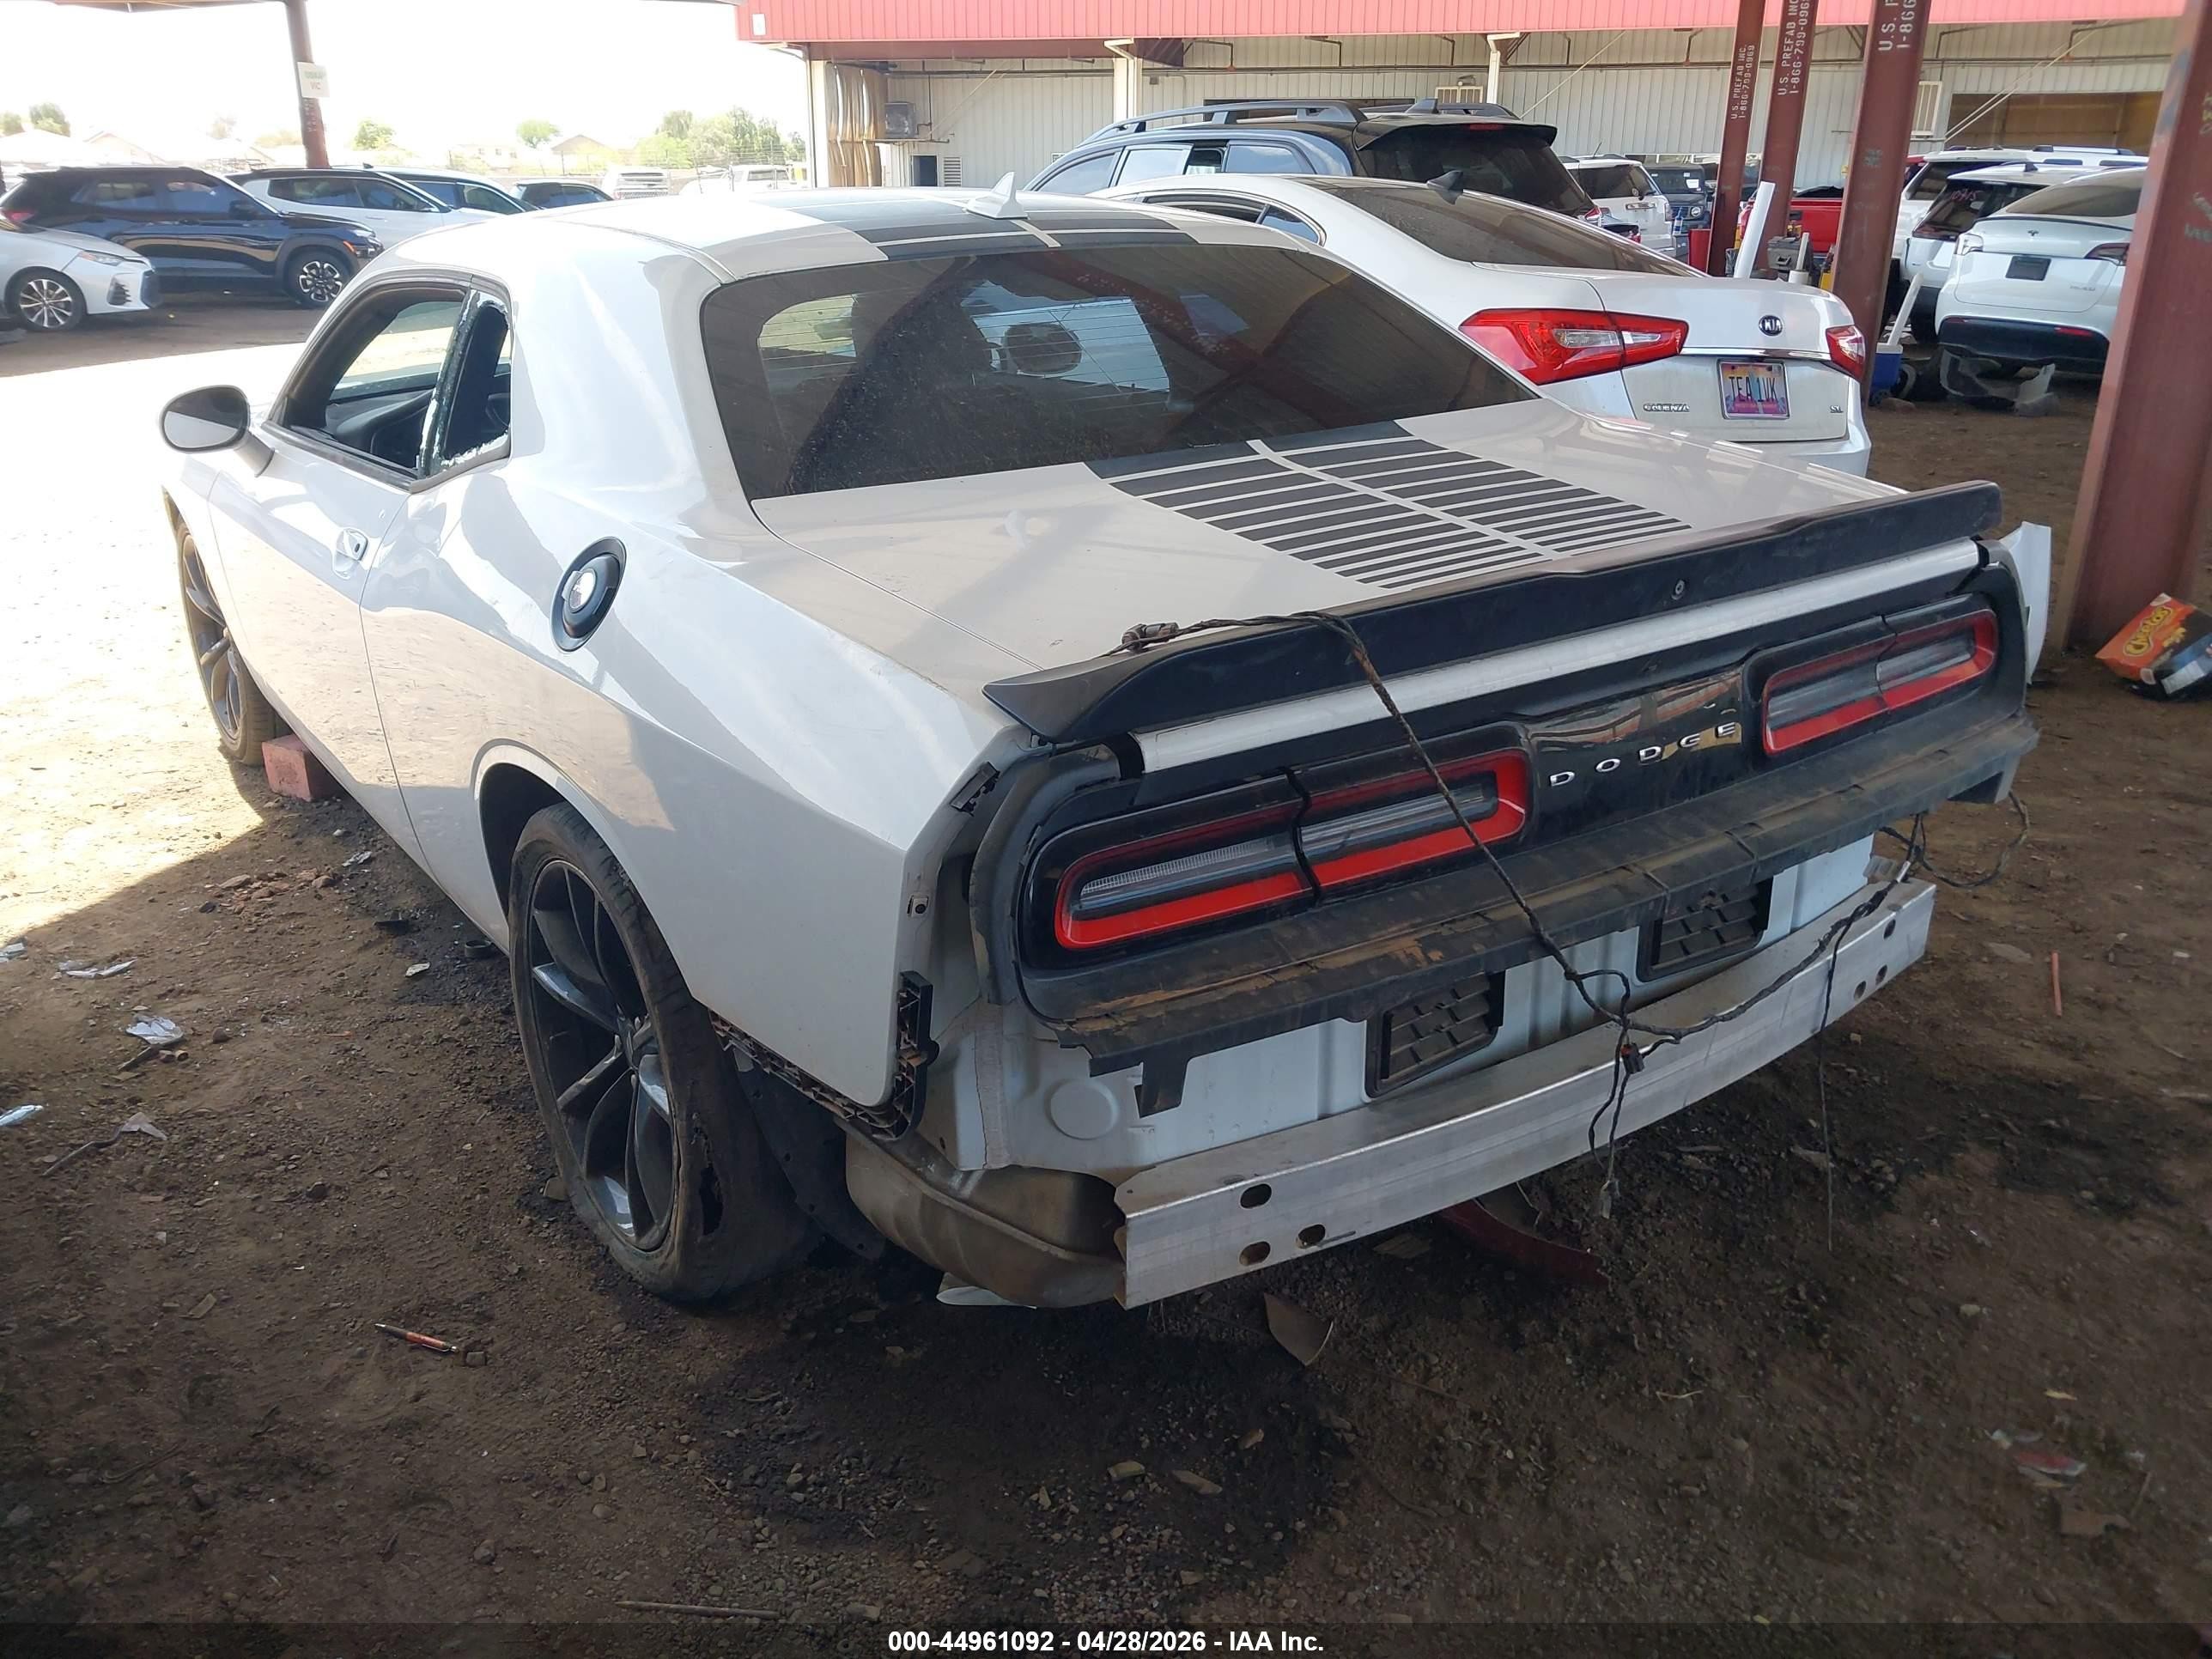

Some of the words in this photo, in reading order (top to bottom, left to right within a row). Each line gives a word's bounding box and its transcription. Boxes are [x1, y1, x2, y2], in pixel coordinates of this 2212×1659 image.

[1782, 21, 1796, 67] PREFAB
[1878, 17, 1896, 51] U.S.
[1778, 73, 1790, 95] U.S.
[1763, 318, 1782, 332] KIA
[1550, 722, 1736, 787] DODGE
